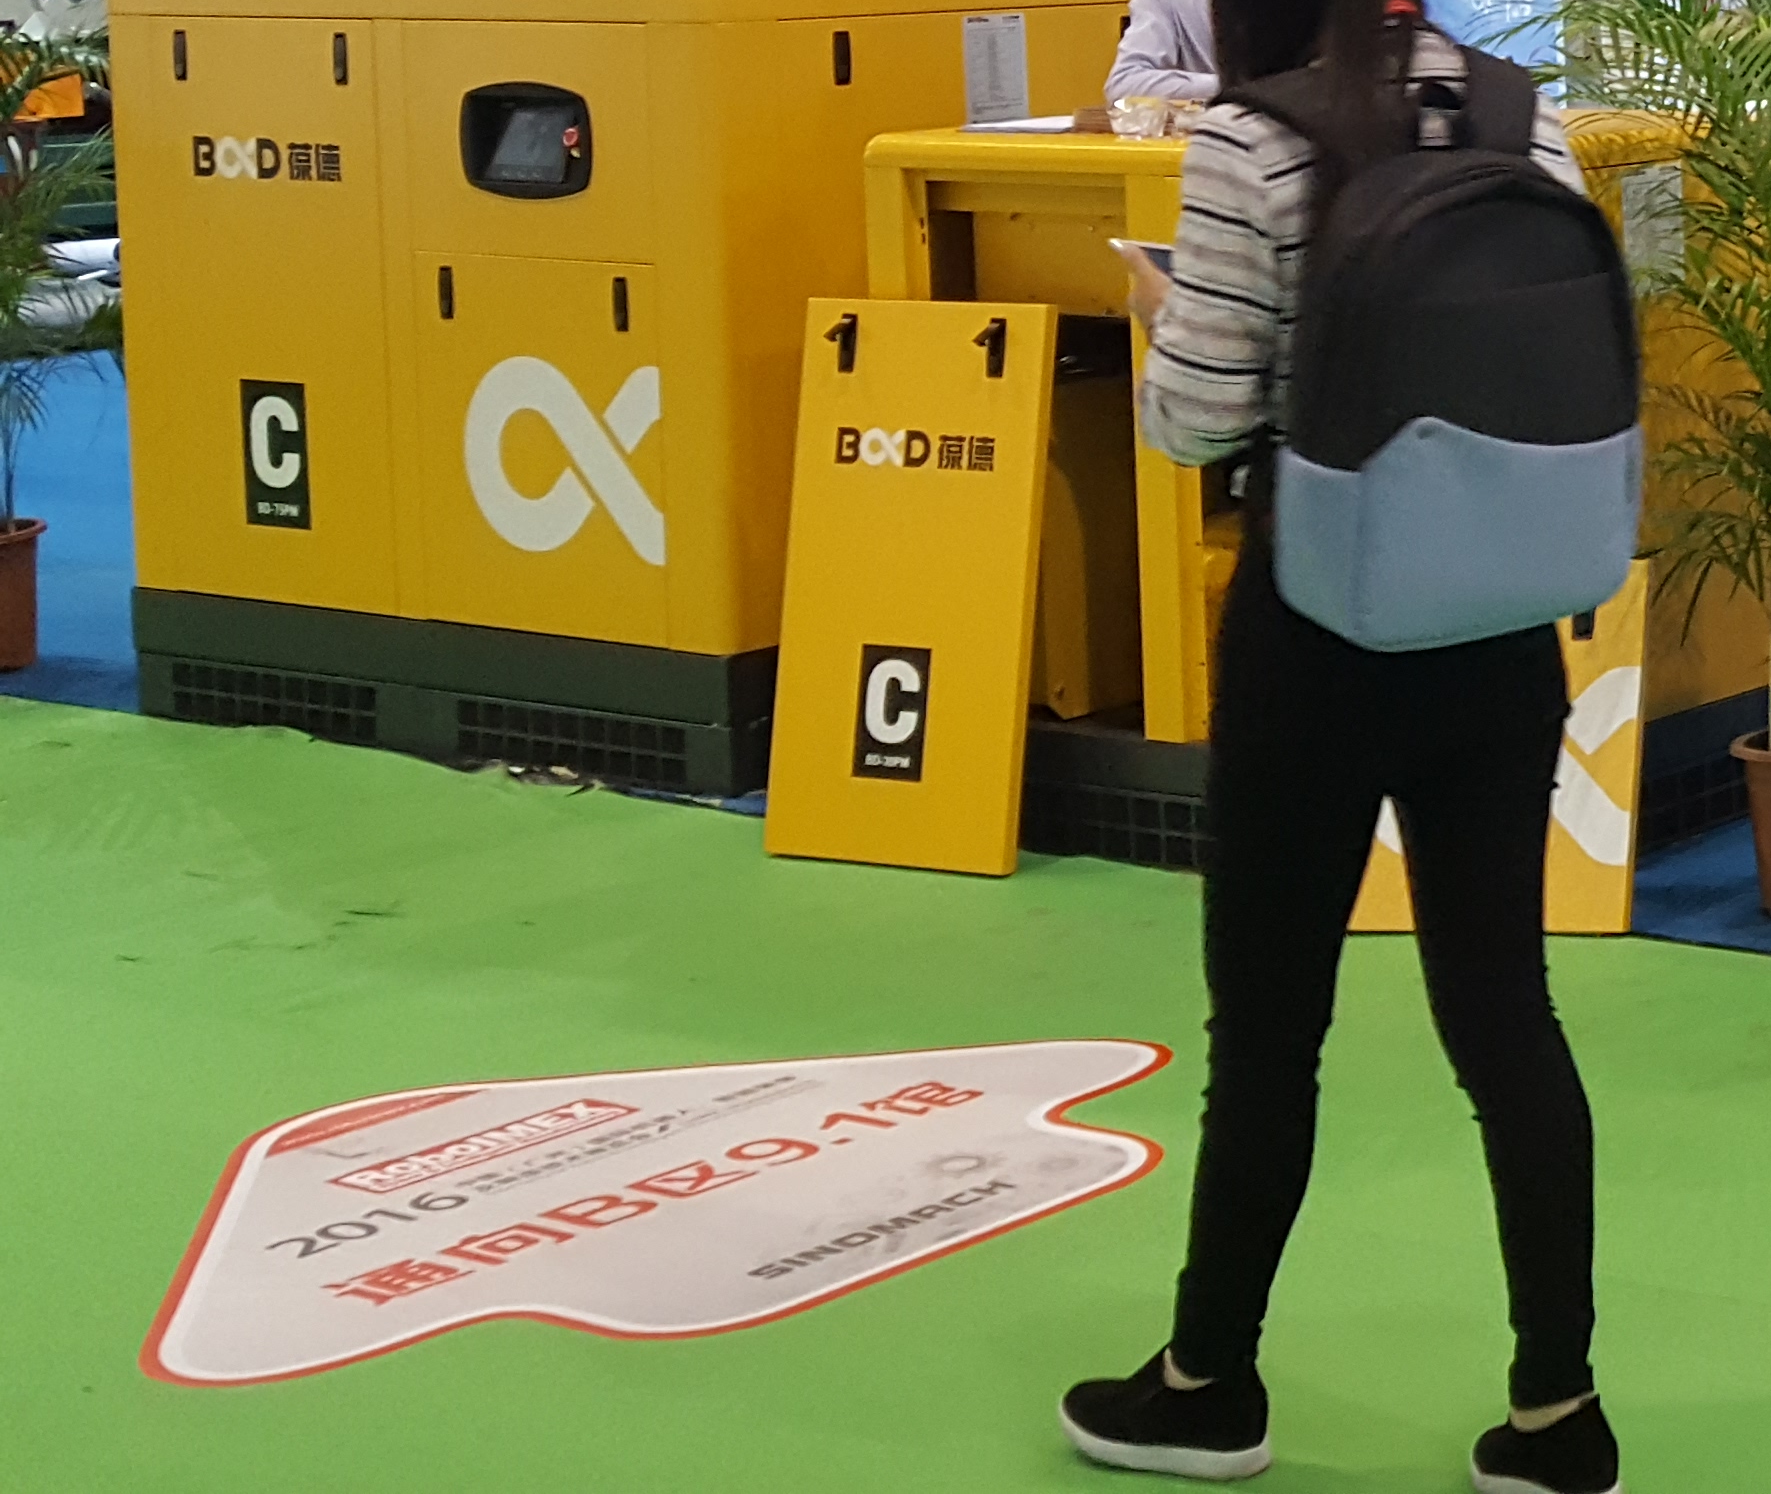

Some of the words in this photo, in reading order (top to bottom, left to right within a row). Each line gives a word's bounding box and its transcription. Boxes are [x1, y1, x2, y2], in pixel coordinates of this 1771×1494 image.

[249, 395, 301, 489] C
[865, 659, 921, 744] C
[265, 1191, 470, 1259] 2016
[321, 1081, 985, 1305] 通向B区9.1馆
[749, 1179, 1018, 1279] SINOMACH
